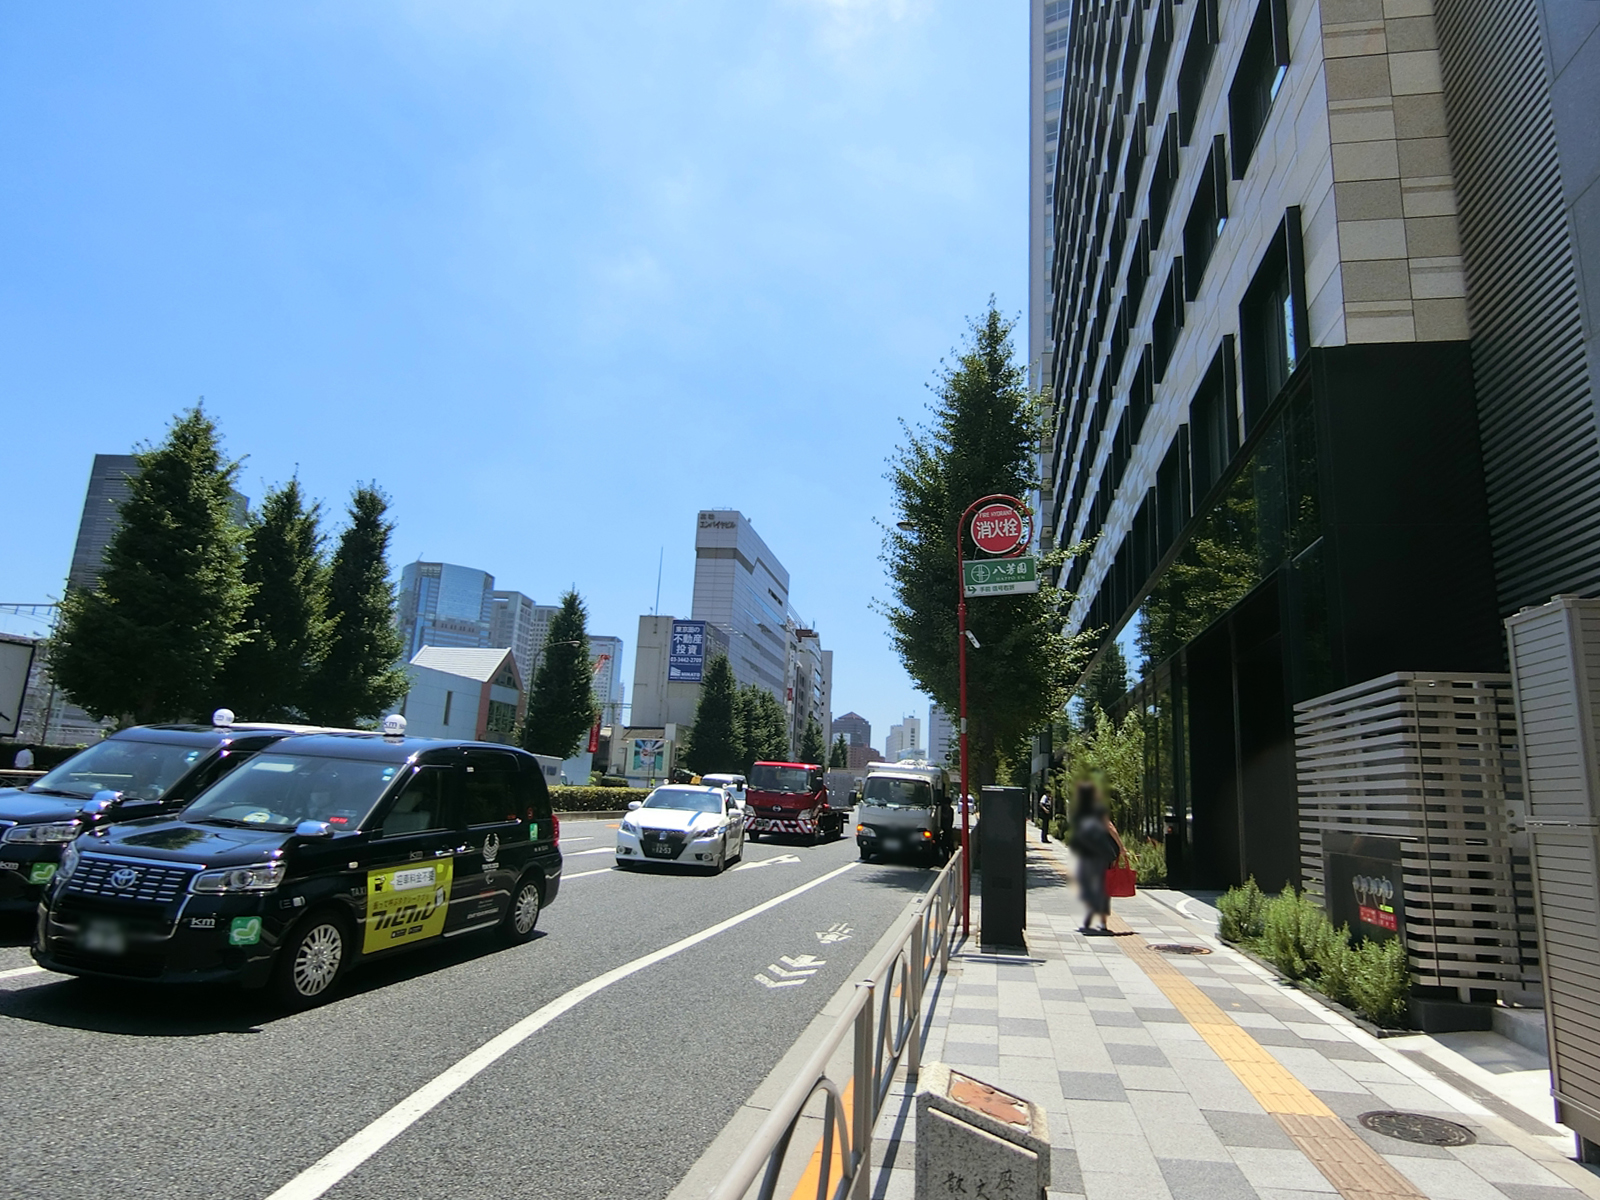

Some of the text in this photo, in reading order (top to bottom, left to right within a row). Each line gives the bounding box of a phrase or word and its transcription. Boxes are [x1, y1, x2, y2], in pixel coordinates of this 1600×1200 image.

[977, 518, 1018, 539] 消火栓
[674, 634, 702, 644] 不動産
[676, 644, 698, 655] 投資
[191, 918, 216, 927] km
